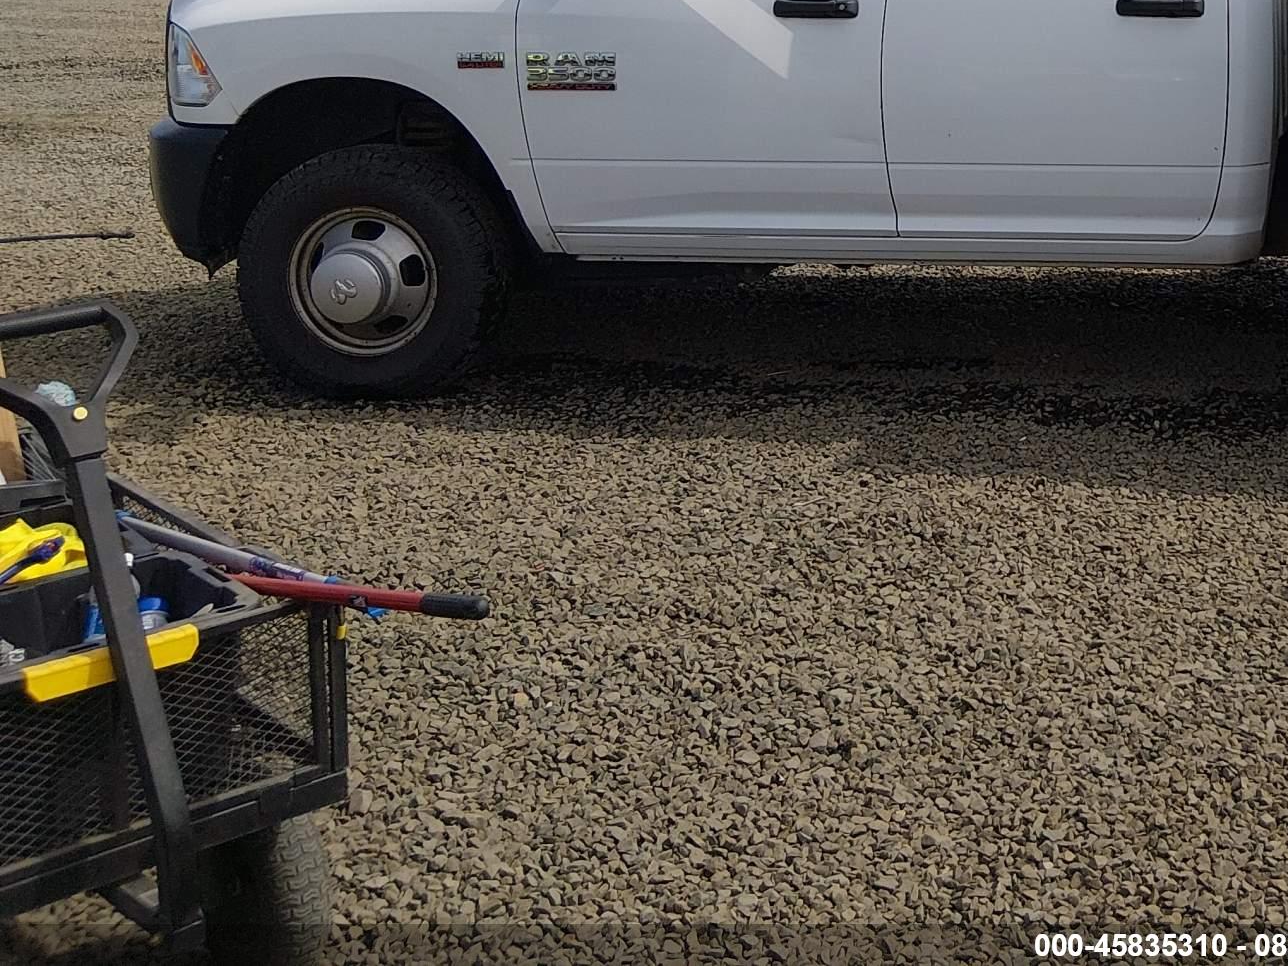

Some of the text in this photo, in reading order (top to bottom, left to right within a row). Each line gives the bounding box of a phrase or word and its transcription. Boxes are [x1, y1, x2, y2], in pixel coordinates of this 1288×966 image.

[456, 51, 505, 62] HEMI
[526, 51, 616, 66] RAM
[526, 67, 616, 81] 3500
